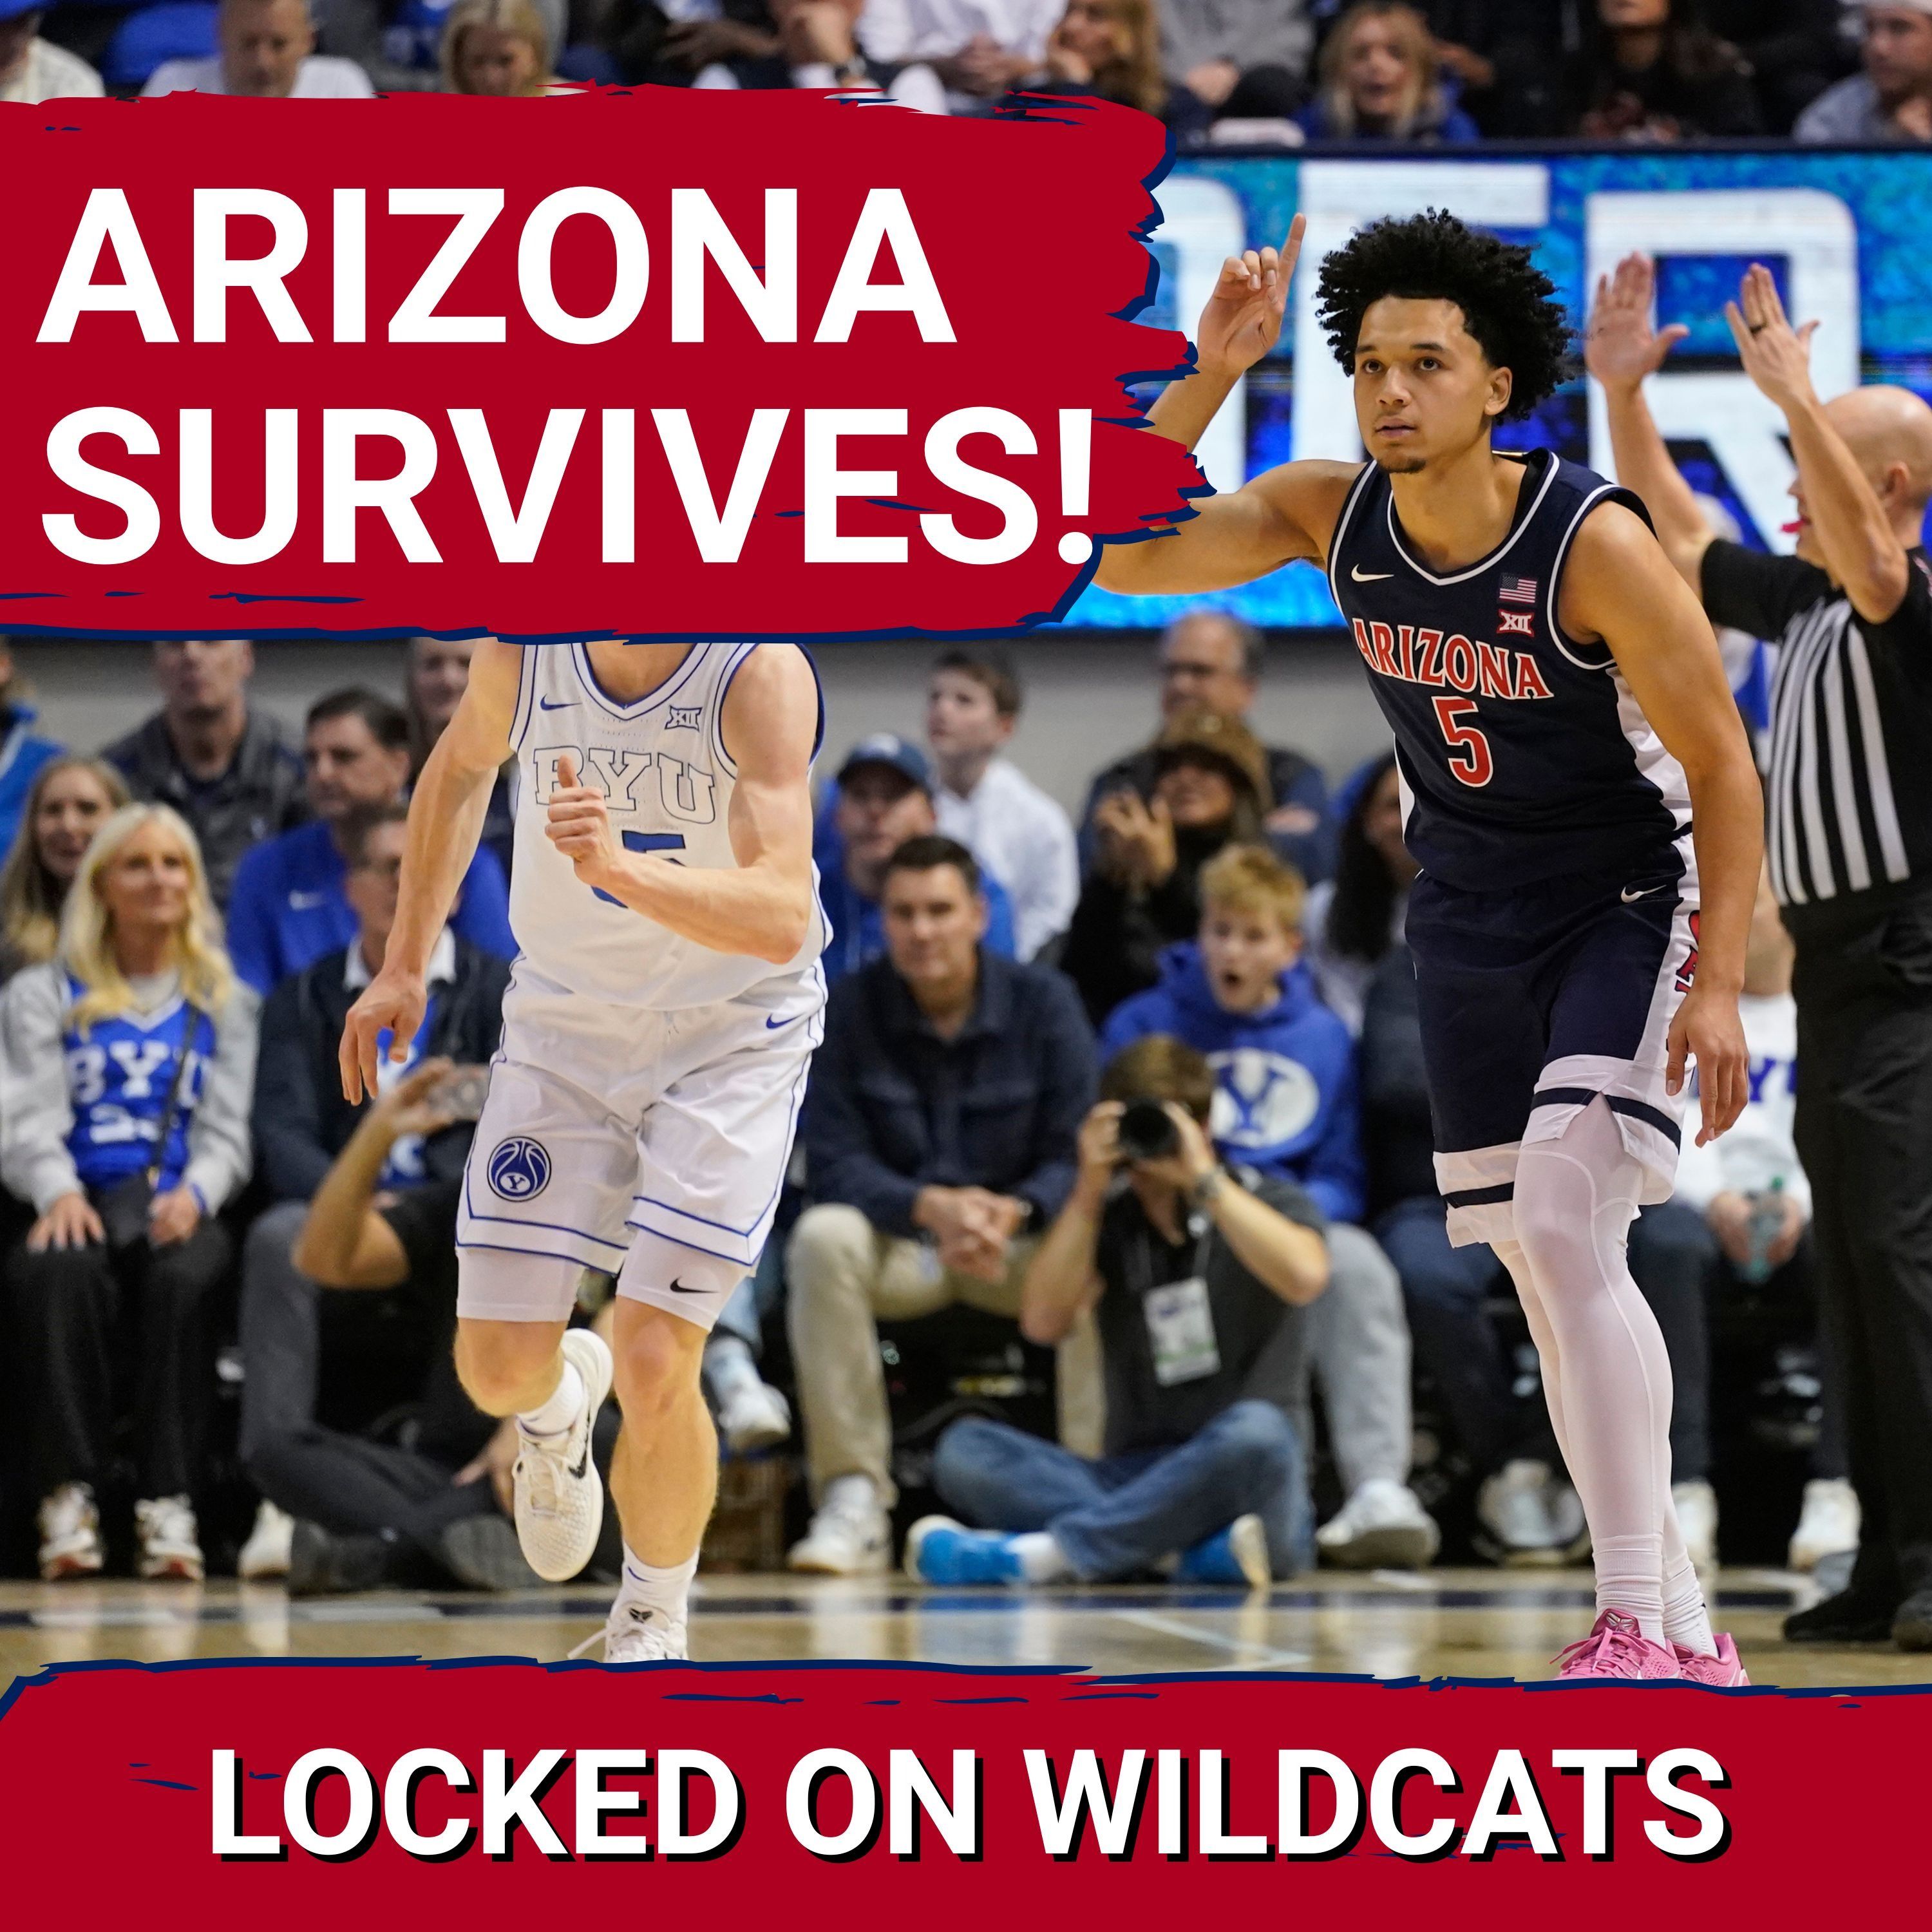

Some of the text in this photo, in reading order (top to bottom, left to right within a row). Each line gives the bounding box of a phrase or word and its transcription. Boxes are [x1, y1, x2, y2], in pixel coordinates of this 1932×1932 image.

[1352, 618, 1554, 699] ARIZONA
[1498, 609, 1535, 636] XII
[1431, 696, 1493, 788] 5
[533, 746, 715, 824] BYU
[506, 1175, 526, 1190] Y
